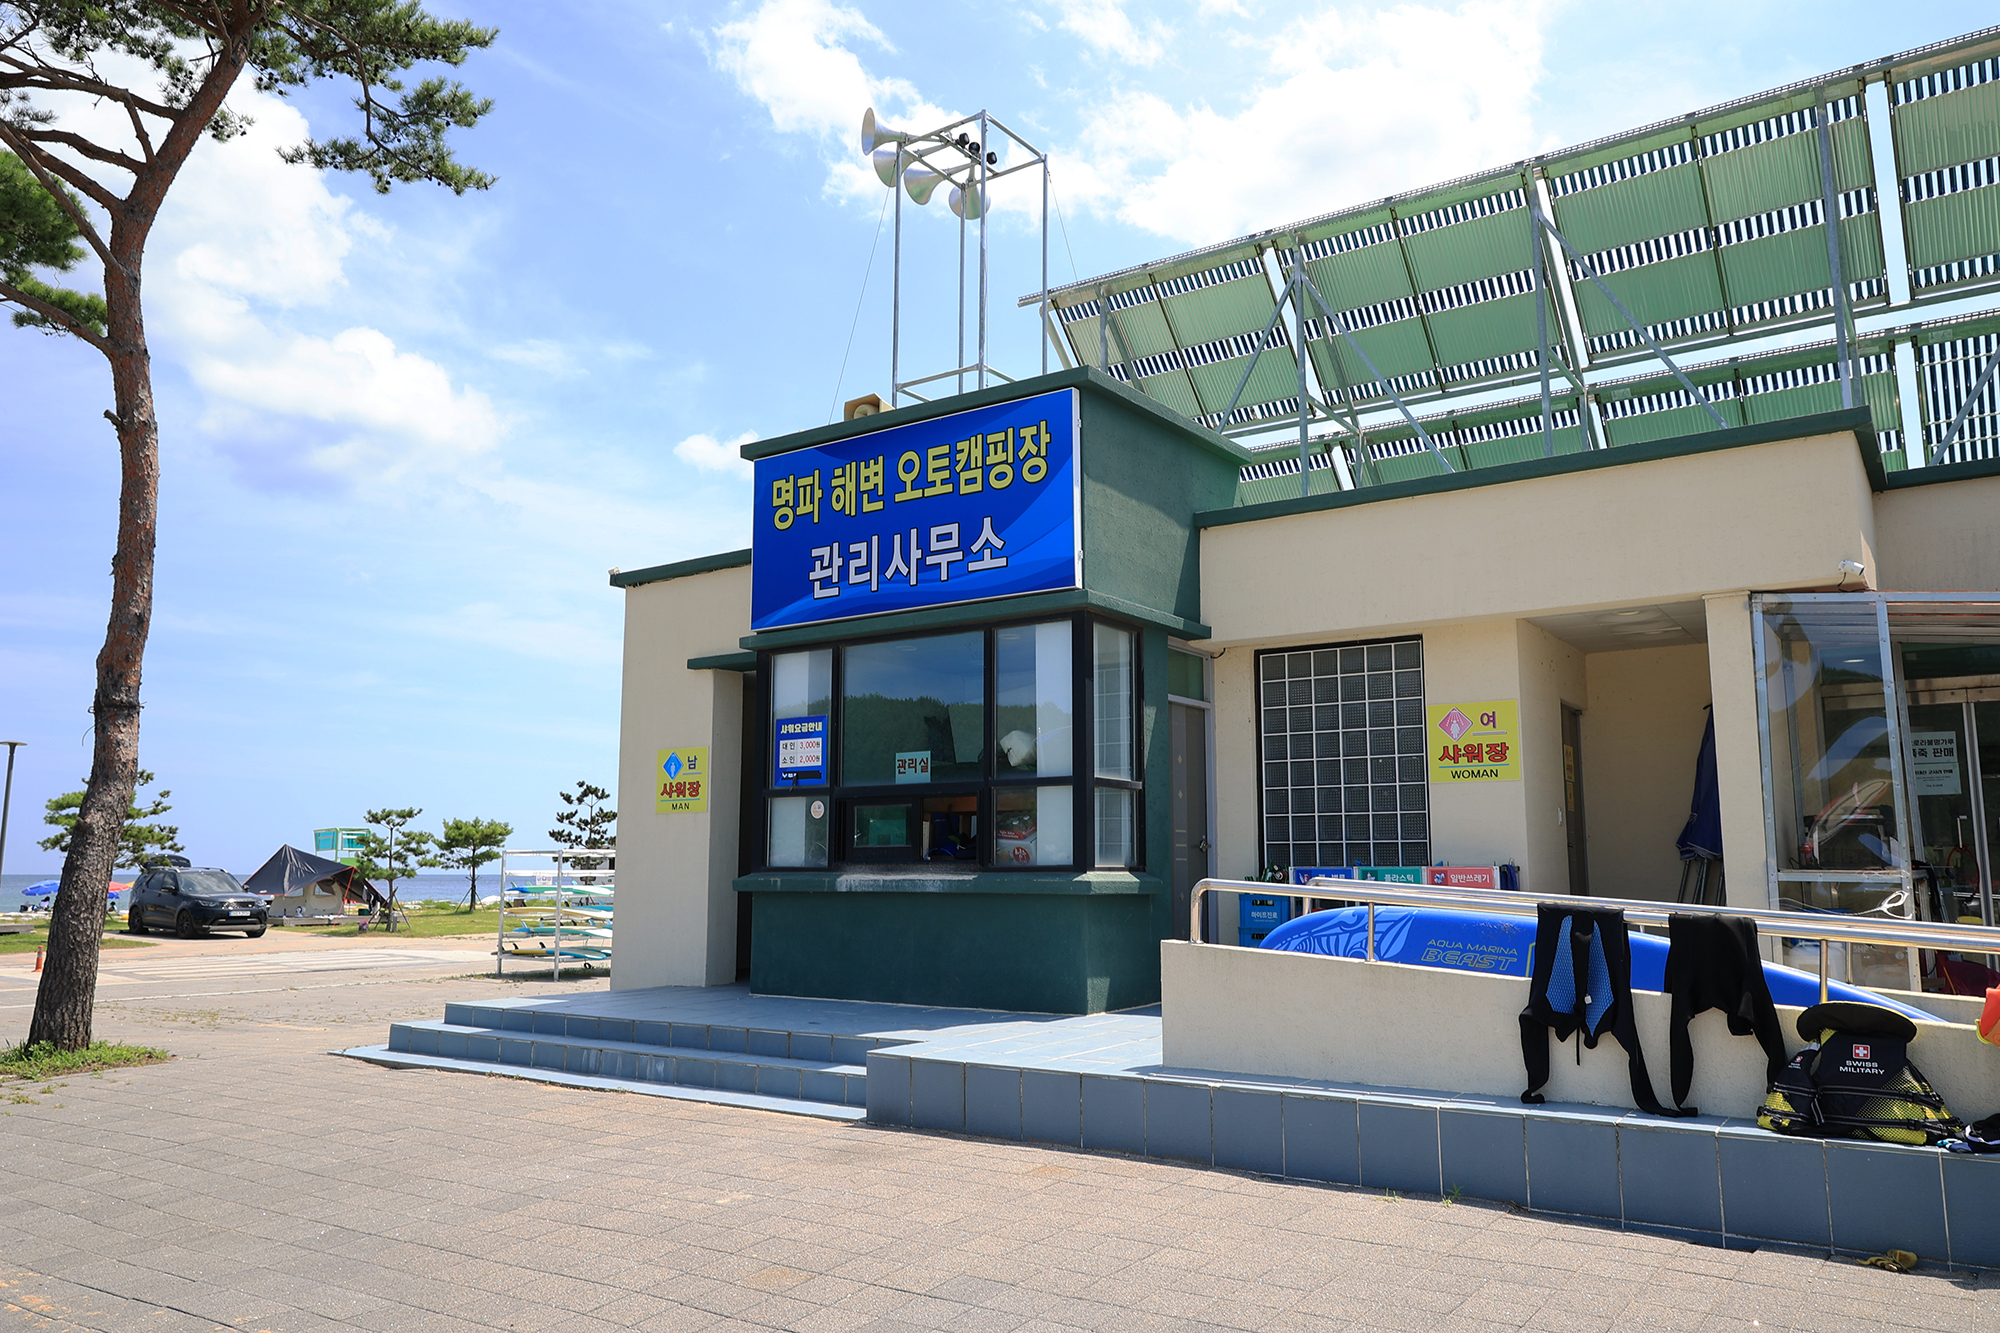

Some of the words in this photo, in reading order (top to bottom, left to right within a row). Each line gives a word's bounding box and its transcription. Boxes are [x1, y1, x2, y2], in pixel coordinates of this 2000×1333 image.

[772, 468, 823, 531] 명파
[830, 454, 885, 517] 해변
[894, 419, 1051, 503] 오토캠핑장
[808, 515, 1008, 600] 관리사무소
[1480, 711, 1496, 729] 여
[780, 722, 822, 734] 샤워요금안내
[1438, 742, 1509, 764] 샤워장
[1932, 747, 1954, 758] 판매
[687, 755, 698, 770] 남
[897, 757, 929, 775] 관리실
[1451, 769, 1499, 779] WOMAN
[660, 781, 701, 798] 샤워장
[1384, 873, 1414, 883] 플라스틱
[1450, 872, 1490, 883] 일반쓰레기
[1427, 939, 1463, 949] AQUA
[1466, 943, 1518, 955] MARINA
[1421, 948, 1517, 971] BEAST
[1839, 1066, 1885, 1075] MILITARY
[1846, 1060, 1878, 1068] SWISS
